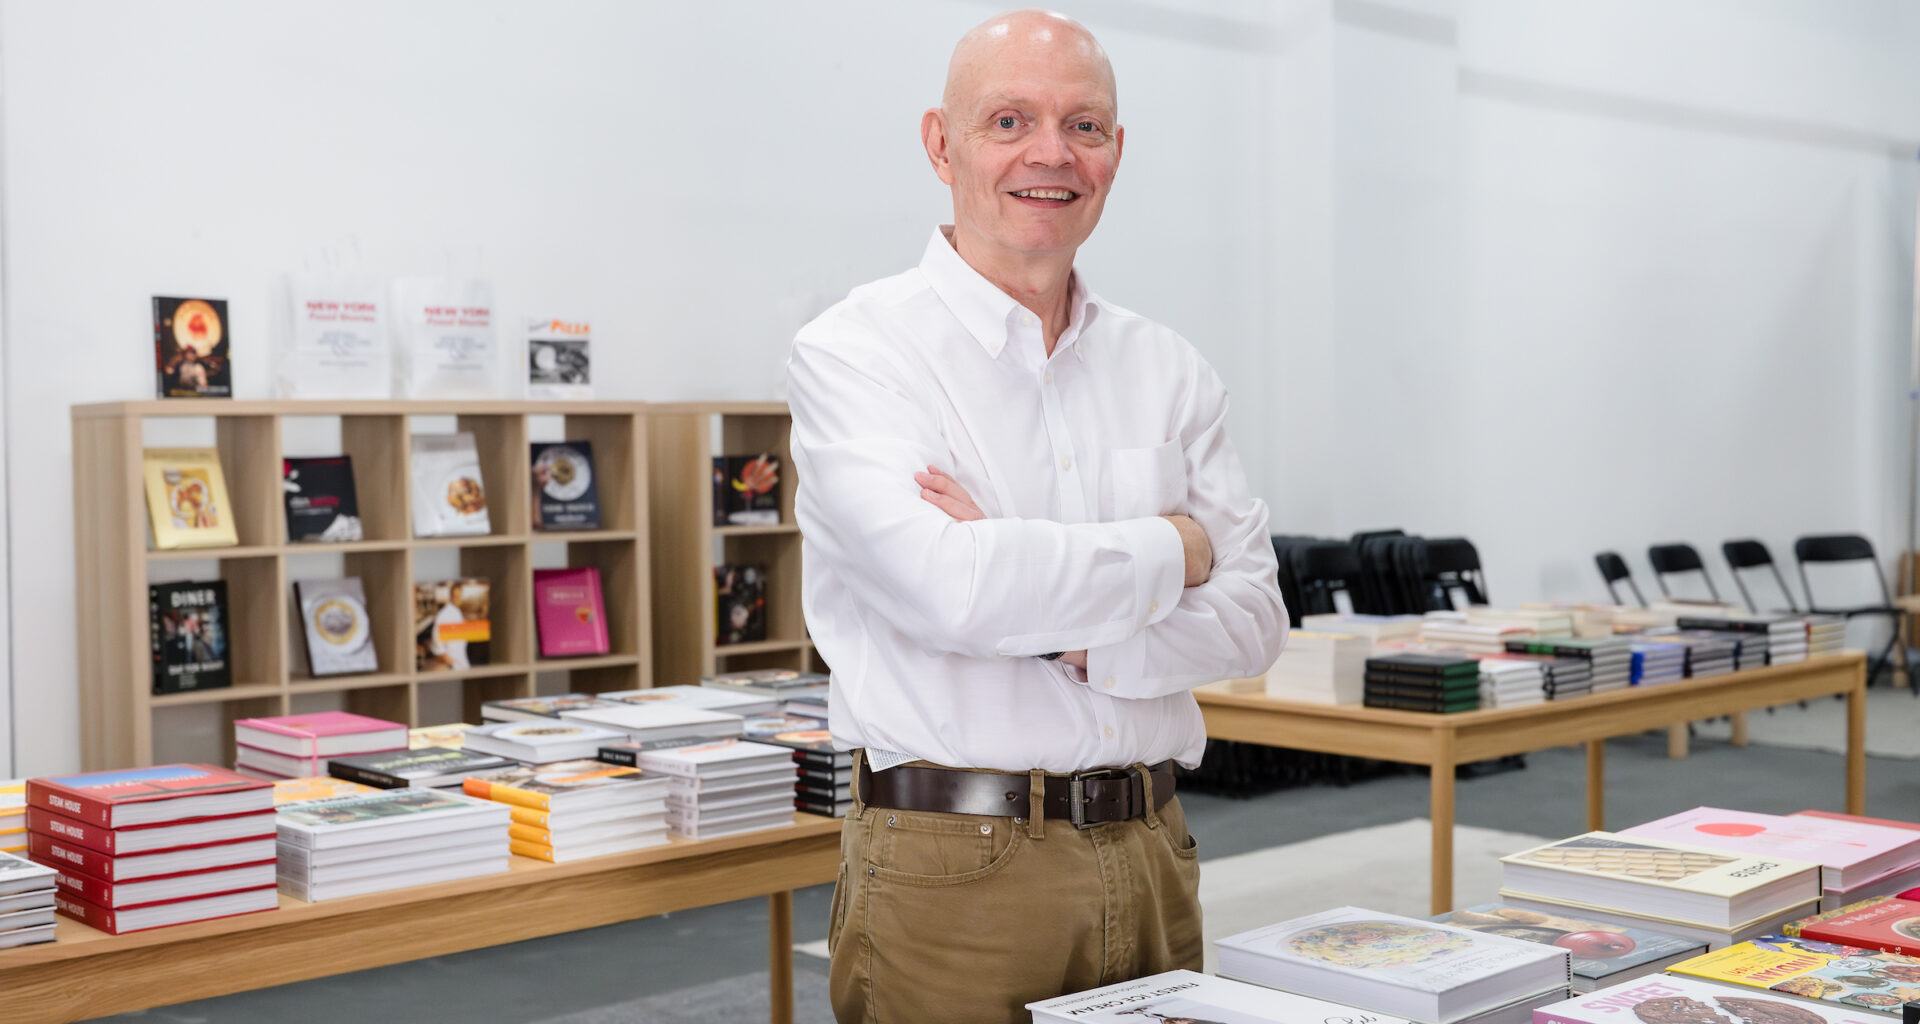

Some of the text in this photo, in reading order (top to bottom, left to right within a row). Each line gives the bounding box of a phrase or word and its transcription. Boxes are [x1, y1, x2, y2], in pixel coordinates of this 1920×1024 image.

[306, 301, 339, 311] NEW
[424, 306, 457, 316] NEW
[170, 589, 216, 608] DINER
[49, 794, 81, 814] STEAK HOUSE
[50, 820, 83, 840] STEAK HOUSE
[51, 845, 83, 866] STEAK HOUSE
[67, 876, 83, 892] HOUSE
[69, 902, 85, 917] HOUSE
[1745, 955, 1820, 982] INDIAN
[1066, 982, 1199, 1016] FINEST ICE CREAM
[1581, 982, 1685, 1014] SWEET
